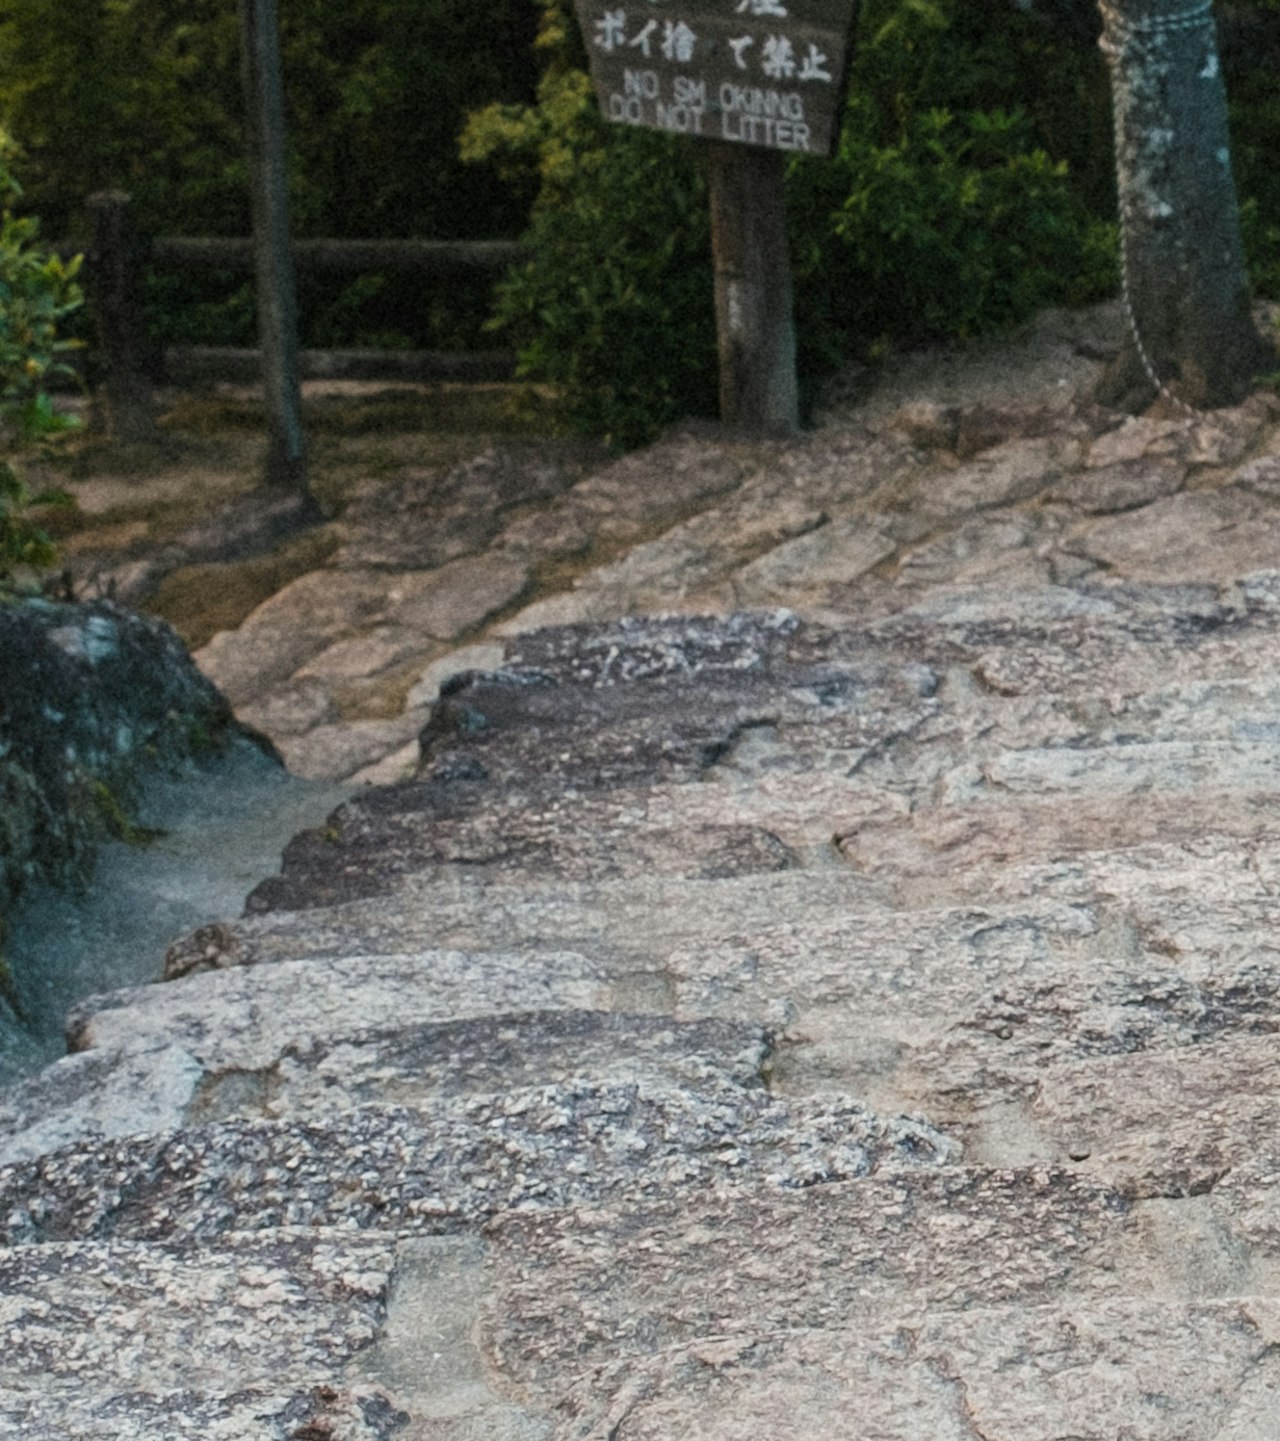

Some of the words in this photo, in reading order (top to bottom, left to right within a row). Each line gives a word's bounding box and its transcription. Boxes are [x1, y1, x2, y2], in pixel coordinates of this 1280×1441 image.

[624, 68, 660, 100] NO
[608, 93, 643, 122] DO
[656, 102, 704, 133] NOT
[721, 112, 811, 153] LITTER
